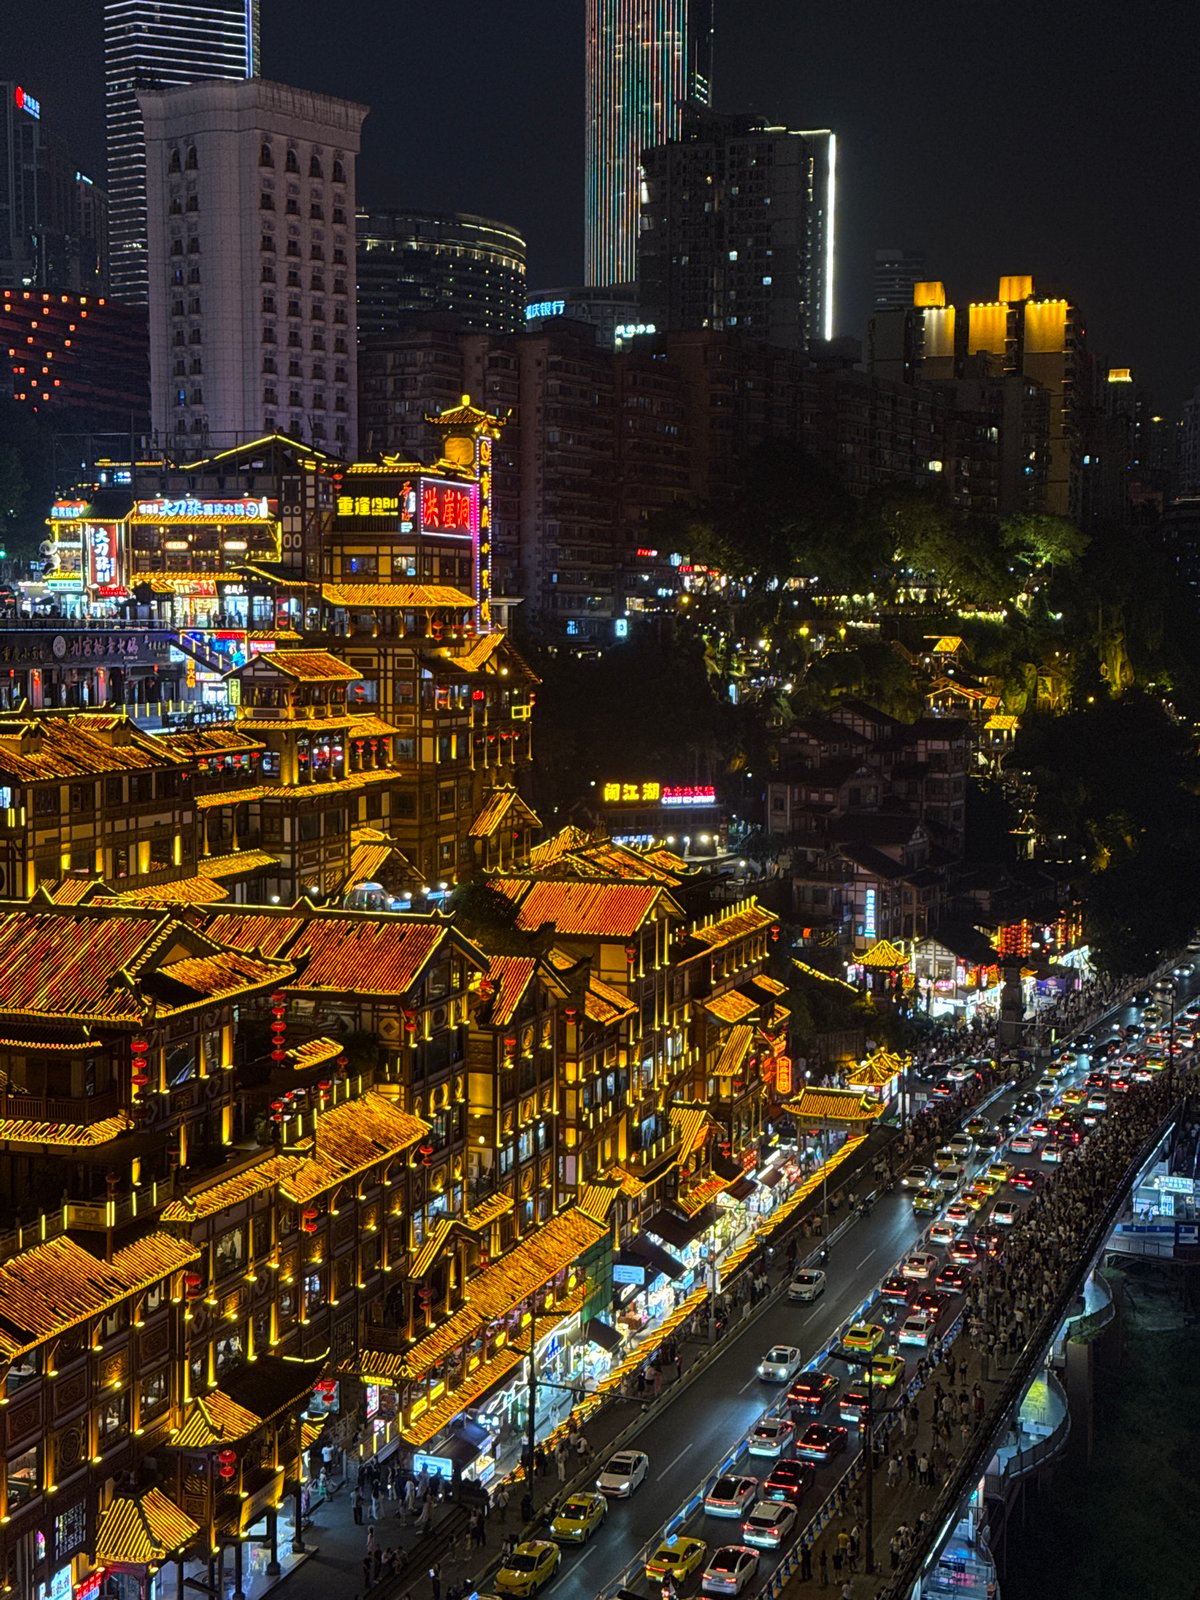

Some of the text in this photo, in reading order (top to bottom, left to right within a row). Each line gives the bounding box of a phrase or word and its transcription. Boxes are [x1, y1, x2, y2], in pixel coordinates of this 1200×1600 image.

[423, 486, 471, 530] 洪崖洞
[70, 636, 139, 657] 九宫格老火锅
